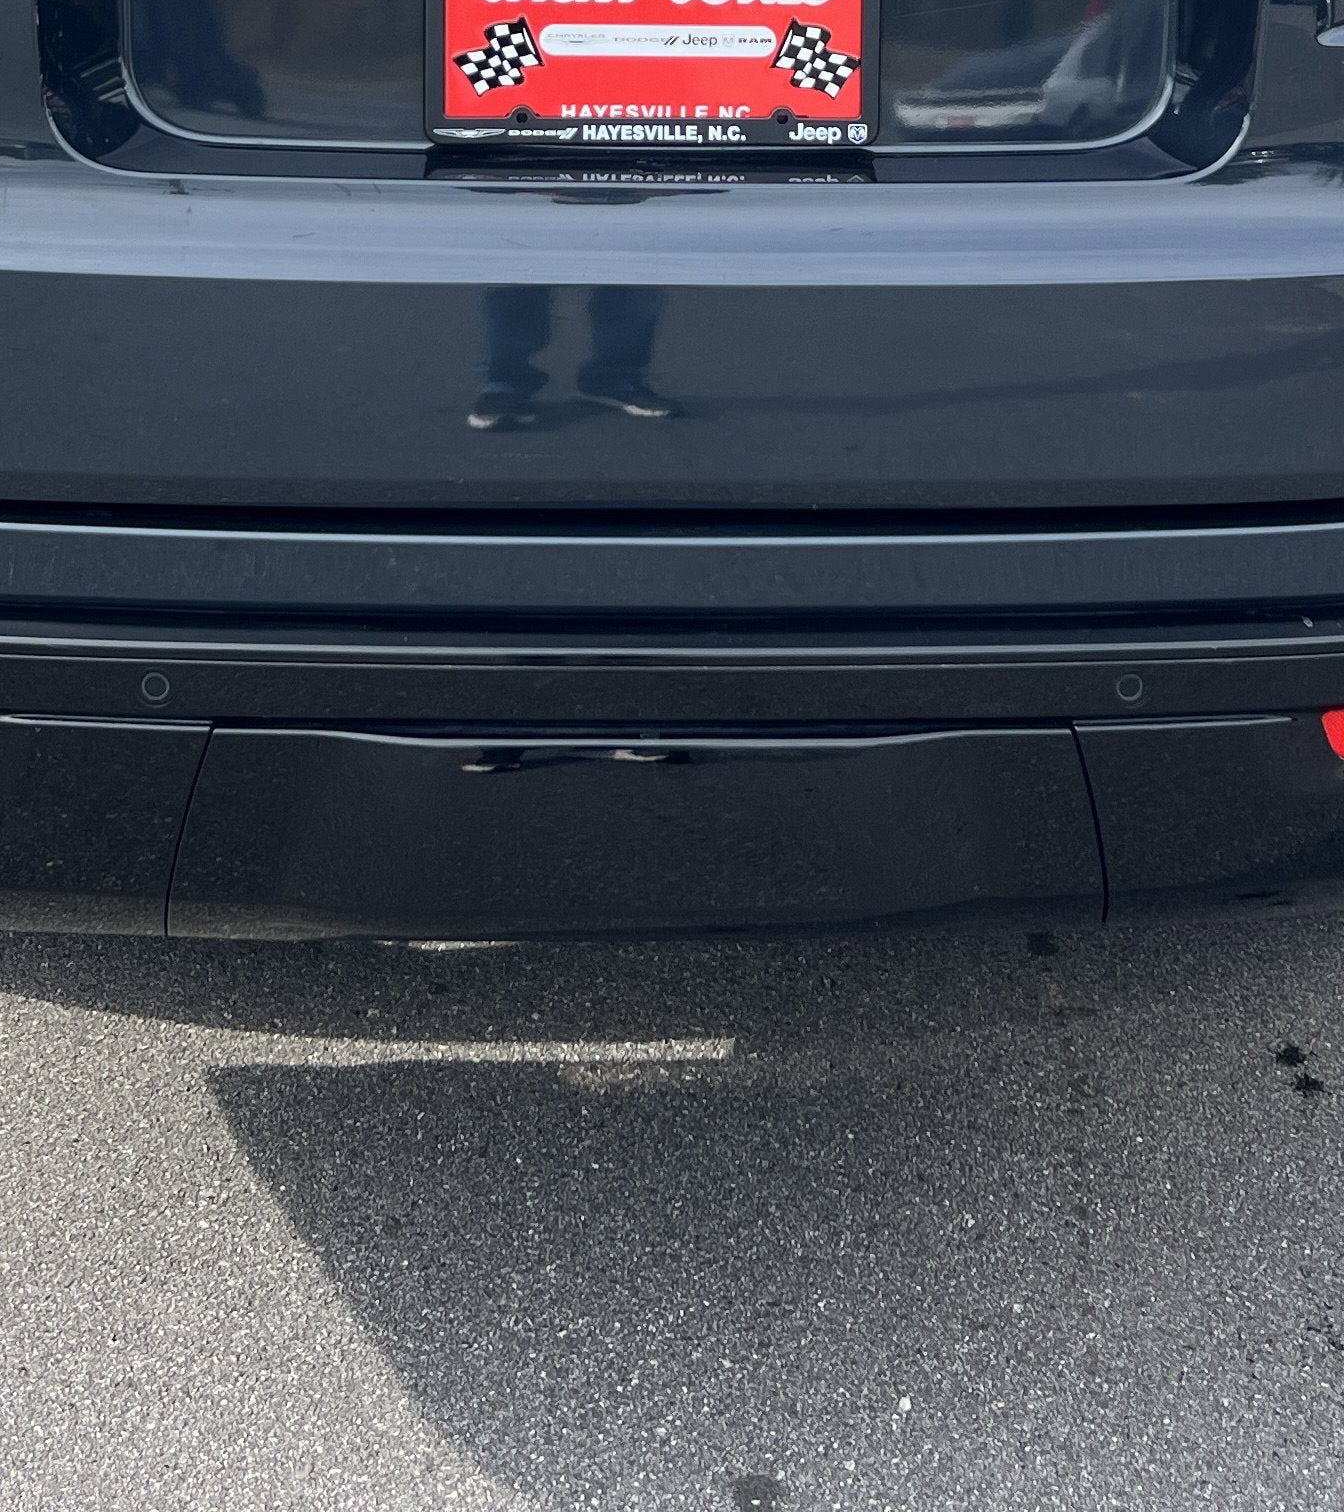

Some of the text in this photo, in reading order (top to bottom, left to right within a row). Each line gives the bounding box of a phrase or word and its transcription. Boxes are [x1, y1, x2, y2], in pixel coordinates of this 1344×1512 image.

[681, 34, 718, 47] Jeep
[582, 124, 703, 144] HAYESVILLE,
[707, 125, 747, 142] N.C.
[788, 122, 842, 144] Jeep
